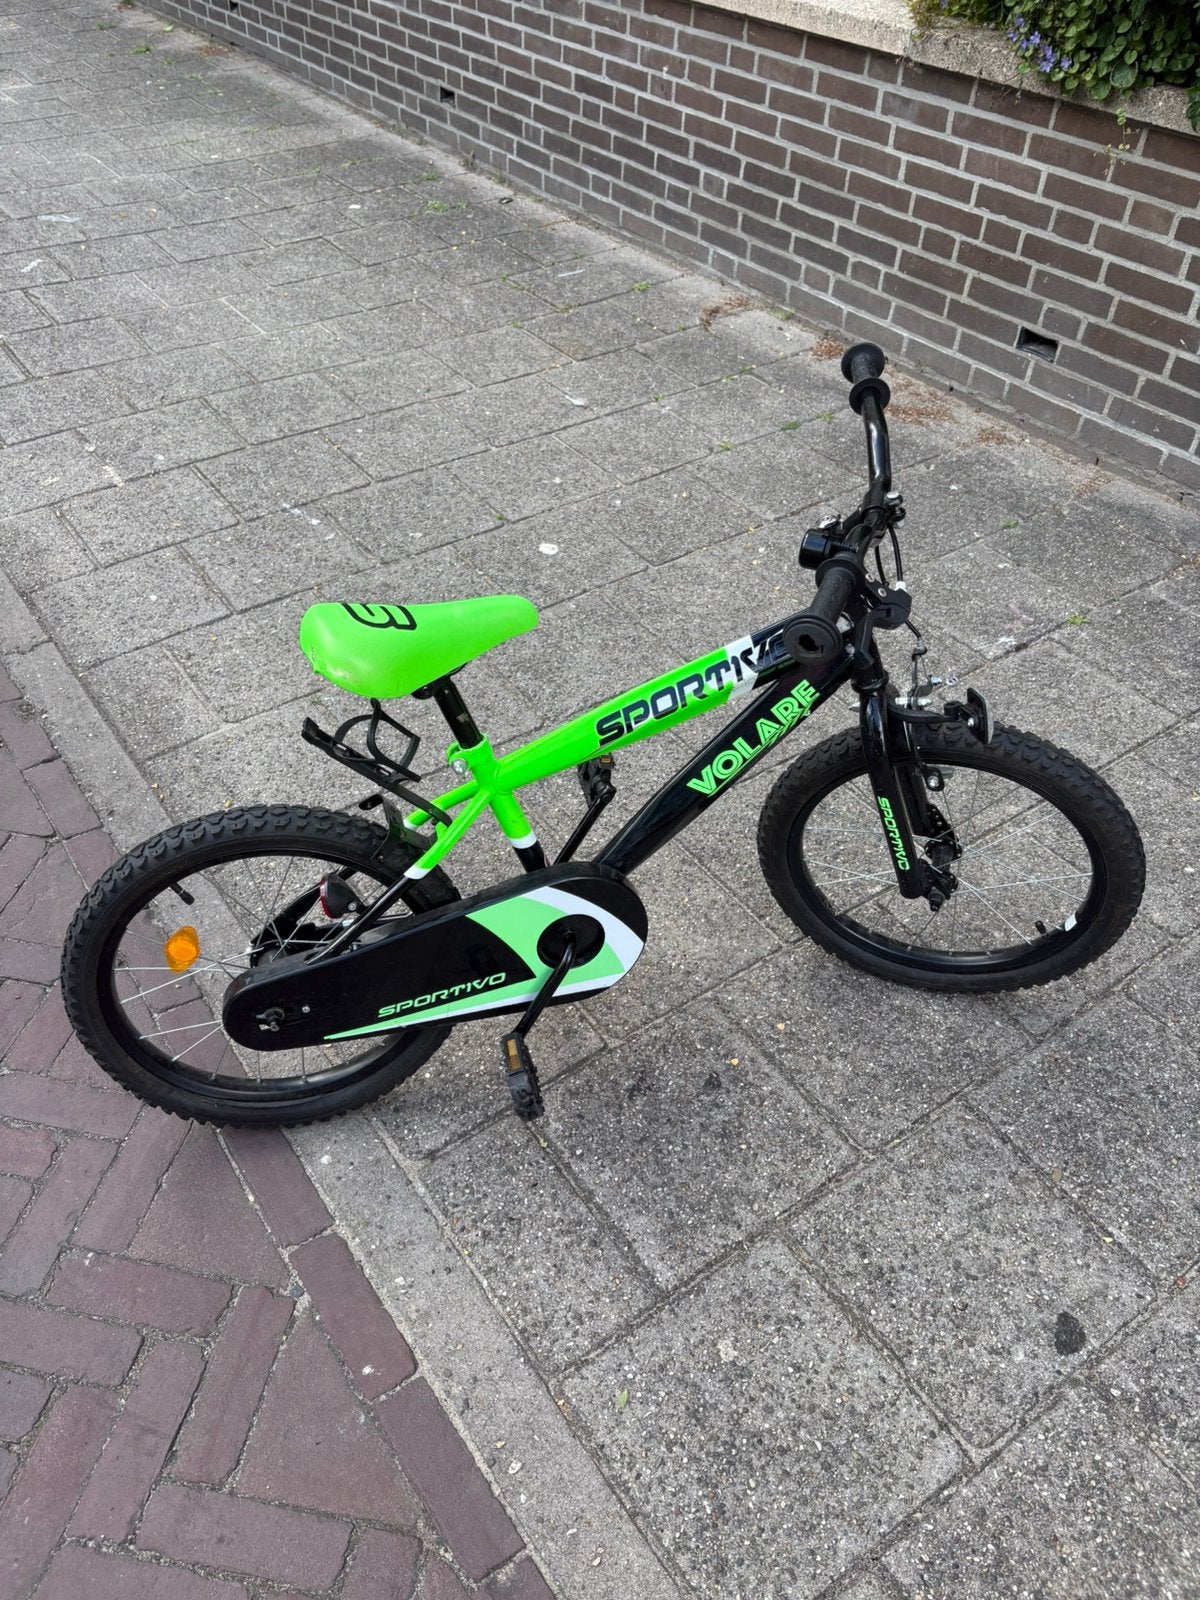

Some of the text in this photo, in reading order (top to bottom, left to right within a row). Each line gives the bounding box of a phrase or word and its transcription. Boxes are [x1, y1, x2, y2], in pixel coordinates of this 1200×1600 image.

[686, 679, 820, 797] VOLARE
[877, 796, 910, 871] SPORTIVO
[377, 972, 506, 1018] SPORTIVO
